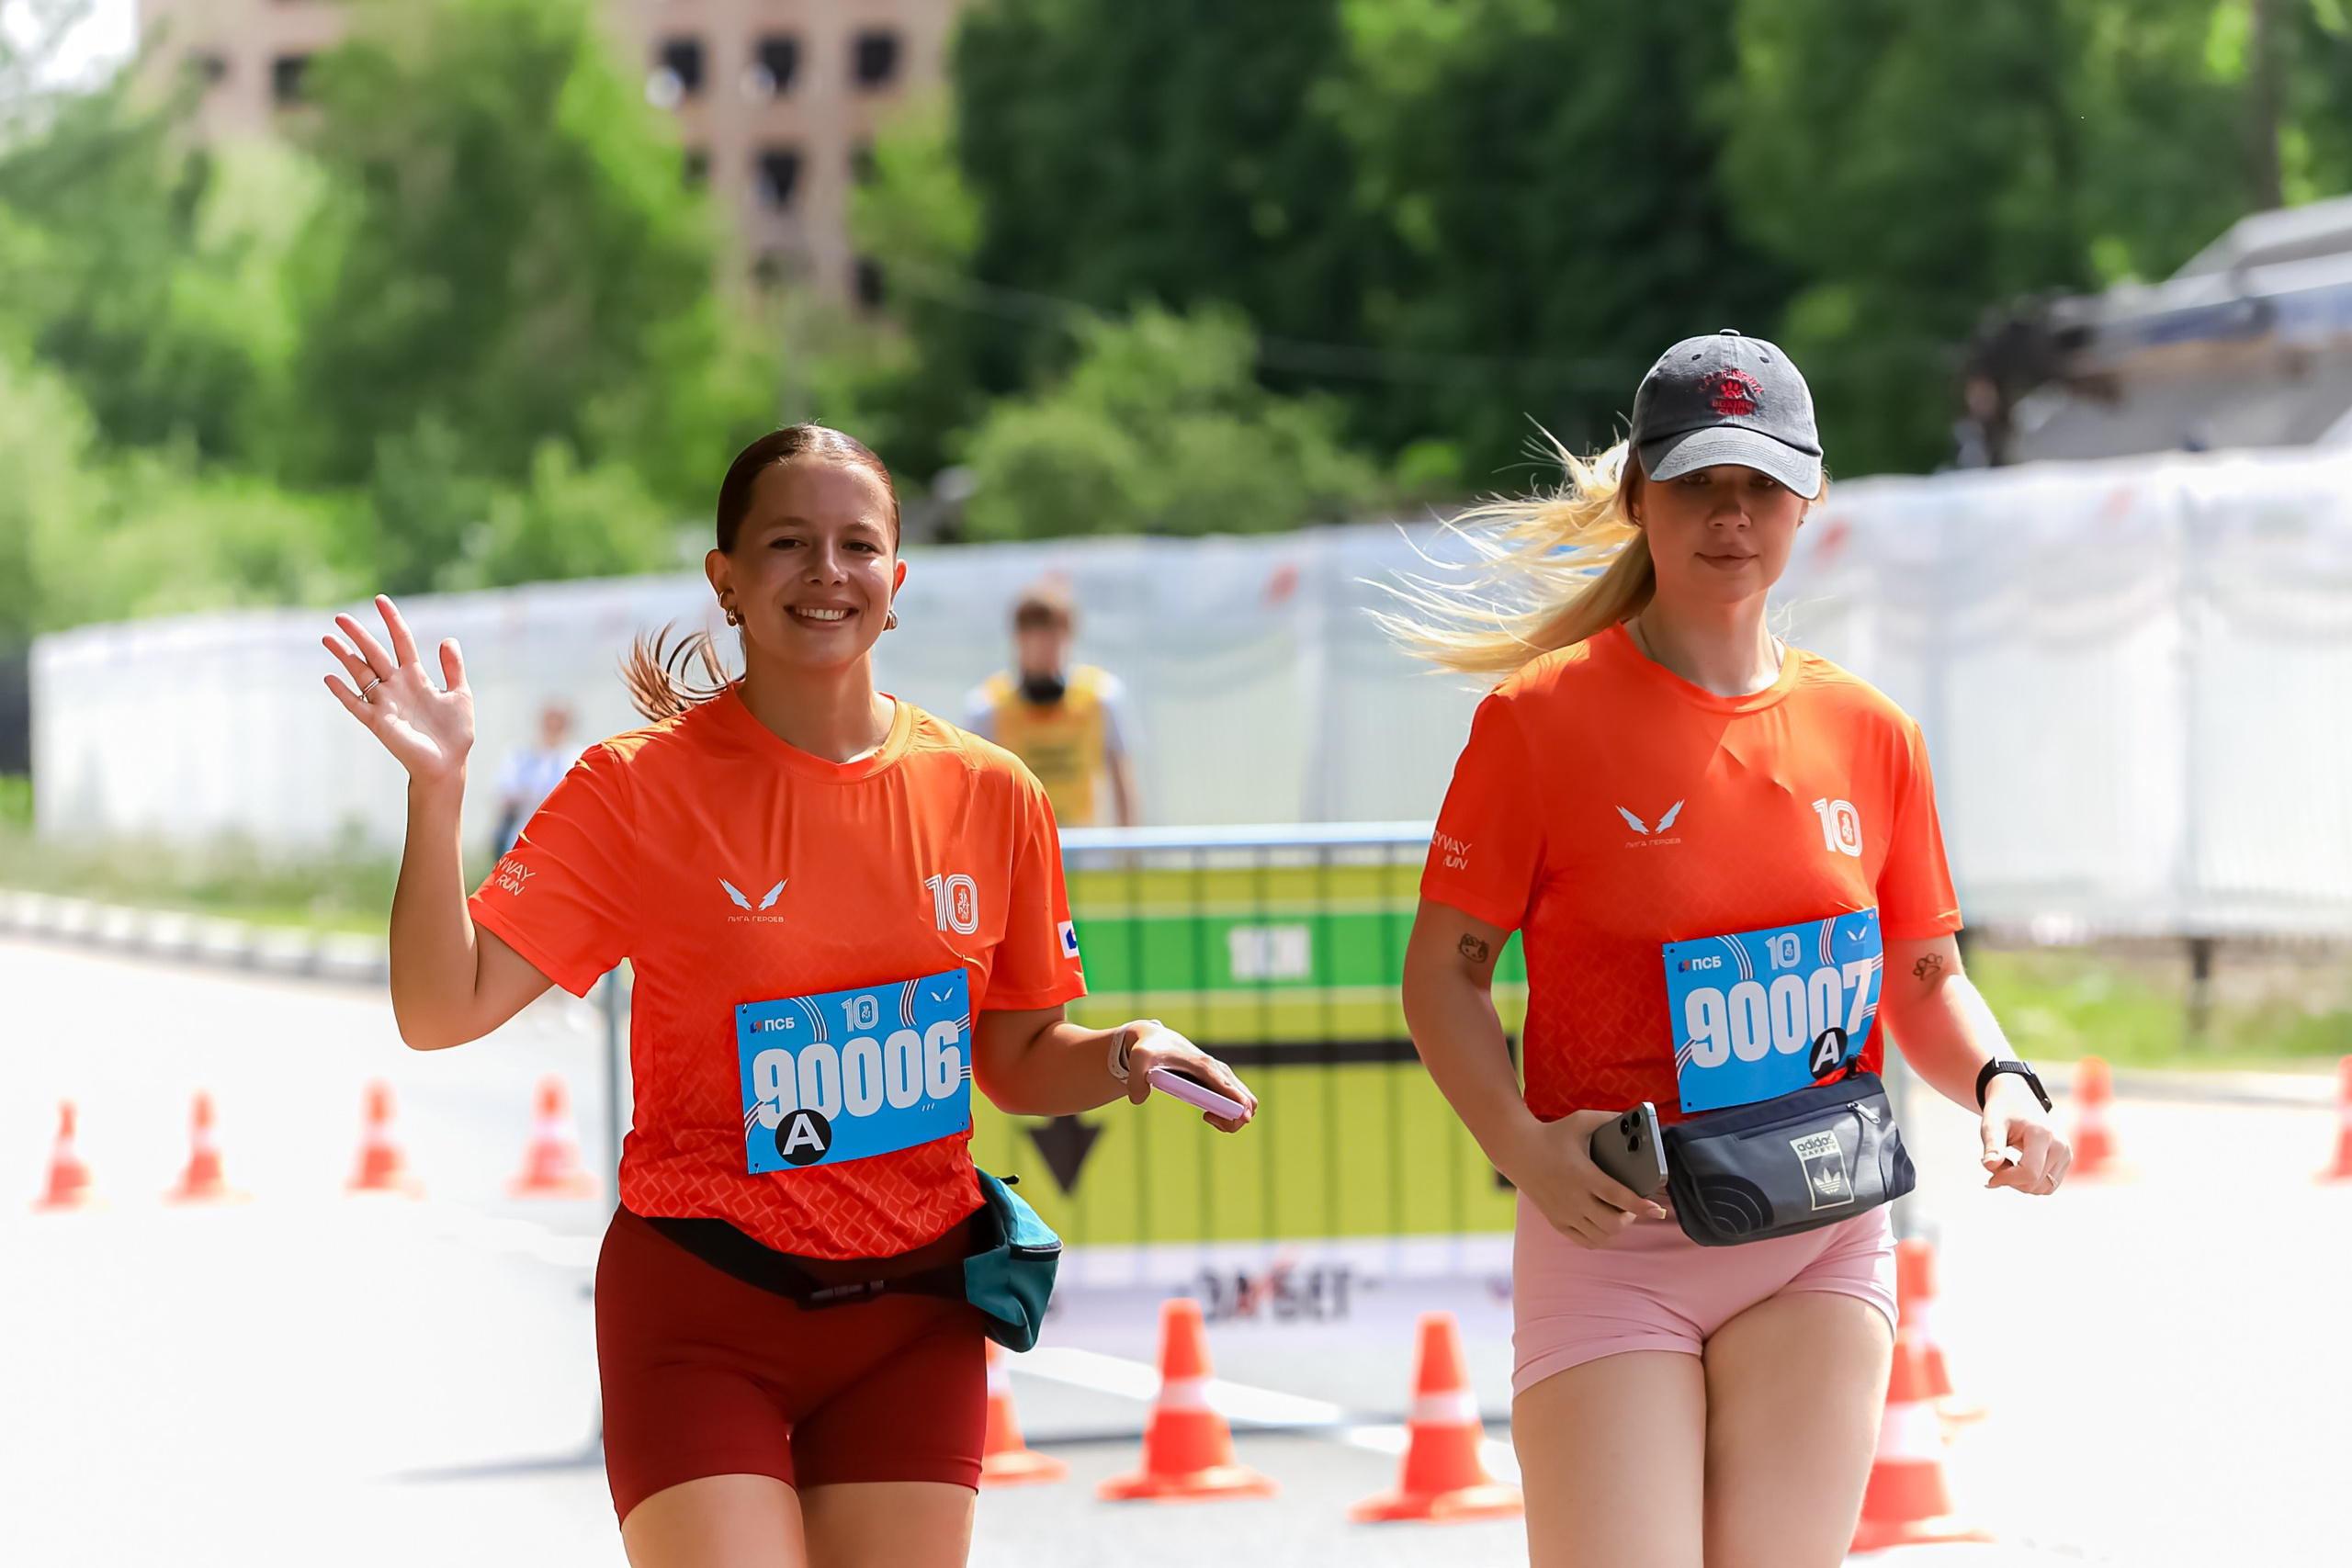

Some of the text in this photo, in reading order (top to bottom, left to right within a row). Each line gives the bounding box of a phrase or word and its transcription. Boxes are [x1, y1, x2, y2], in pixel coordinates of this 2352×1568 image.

[1812, 797, 1863, 857] 10
[495, 874, 525, 897] RUN
[923, 873, 979, 935] 10
[728, 915, 785, 923] ЛИГА ГЕРОЕВ
[1691, 955, 1722, 971] ПСБ
[1765, 932, 1802, 970] 10
[764, 1017, 796, 1032] ПСБ
[842, 994, 879, 1032] 10
[1684, 958, 1872, 1068] 90007
[752, 1020, 962, 1130] 90006
[1801, 1144, 1837, 1157] SAFETY
